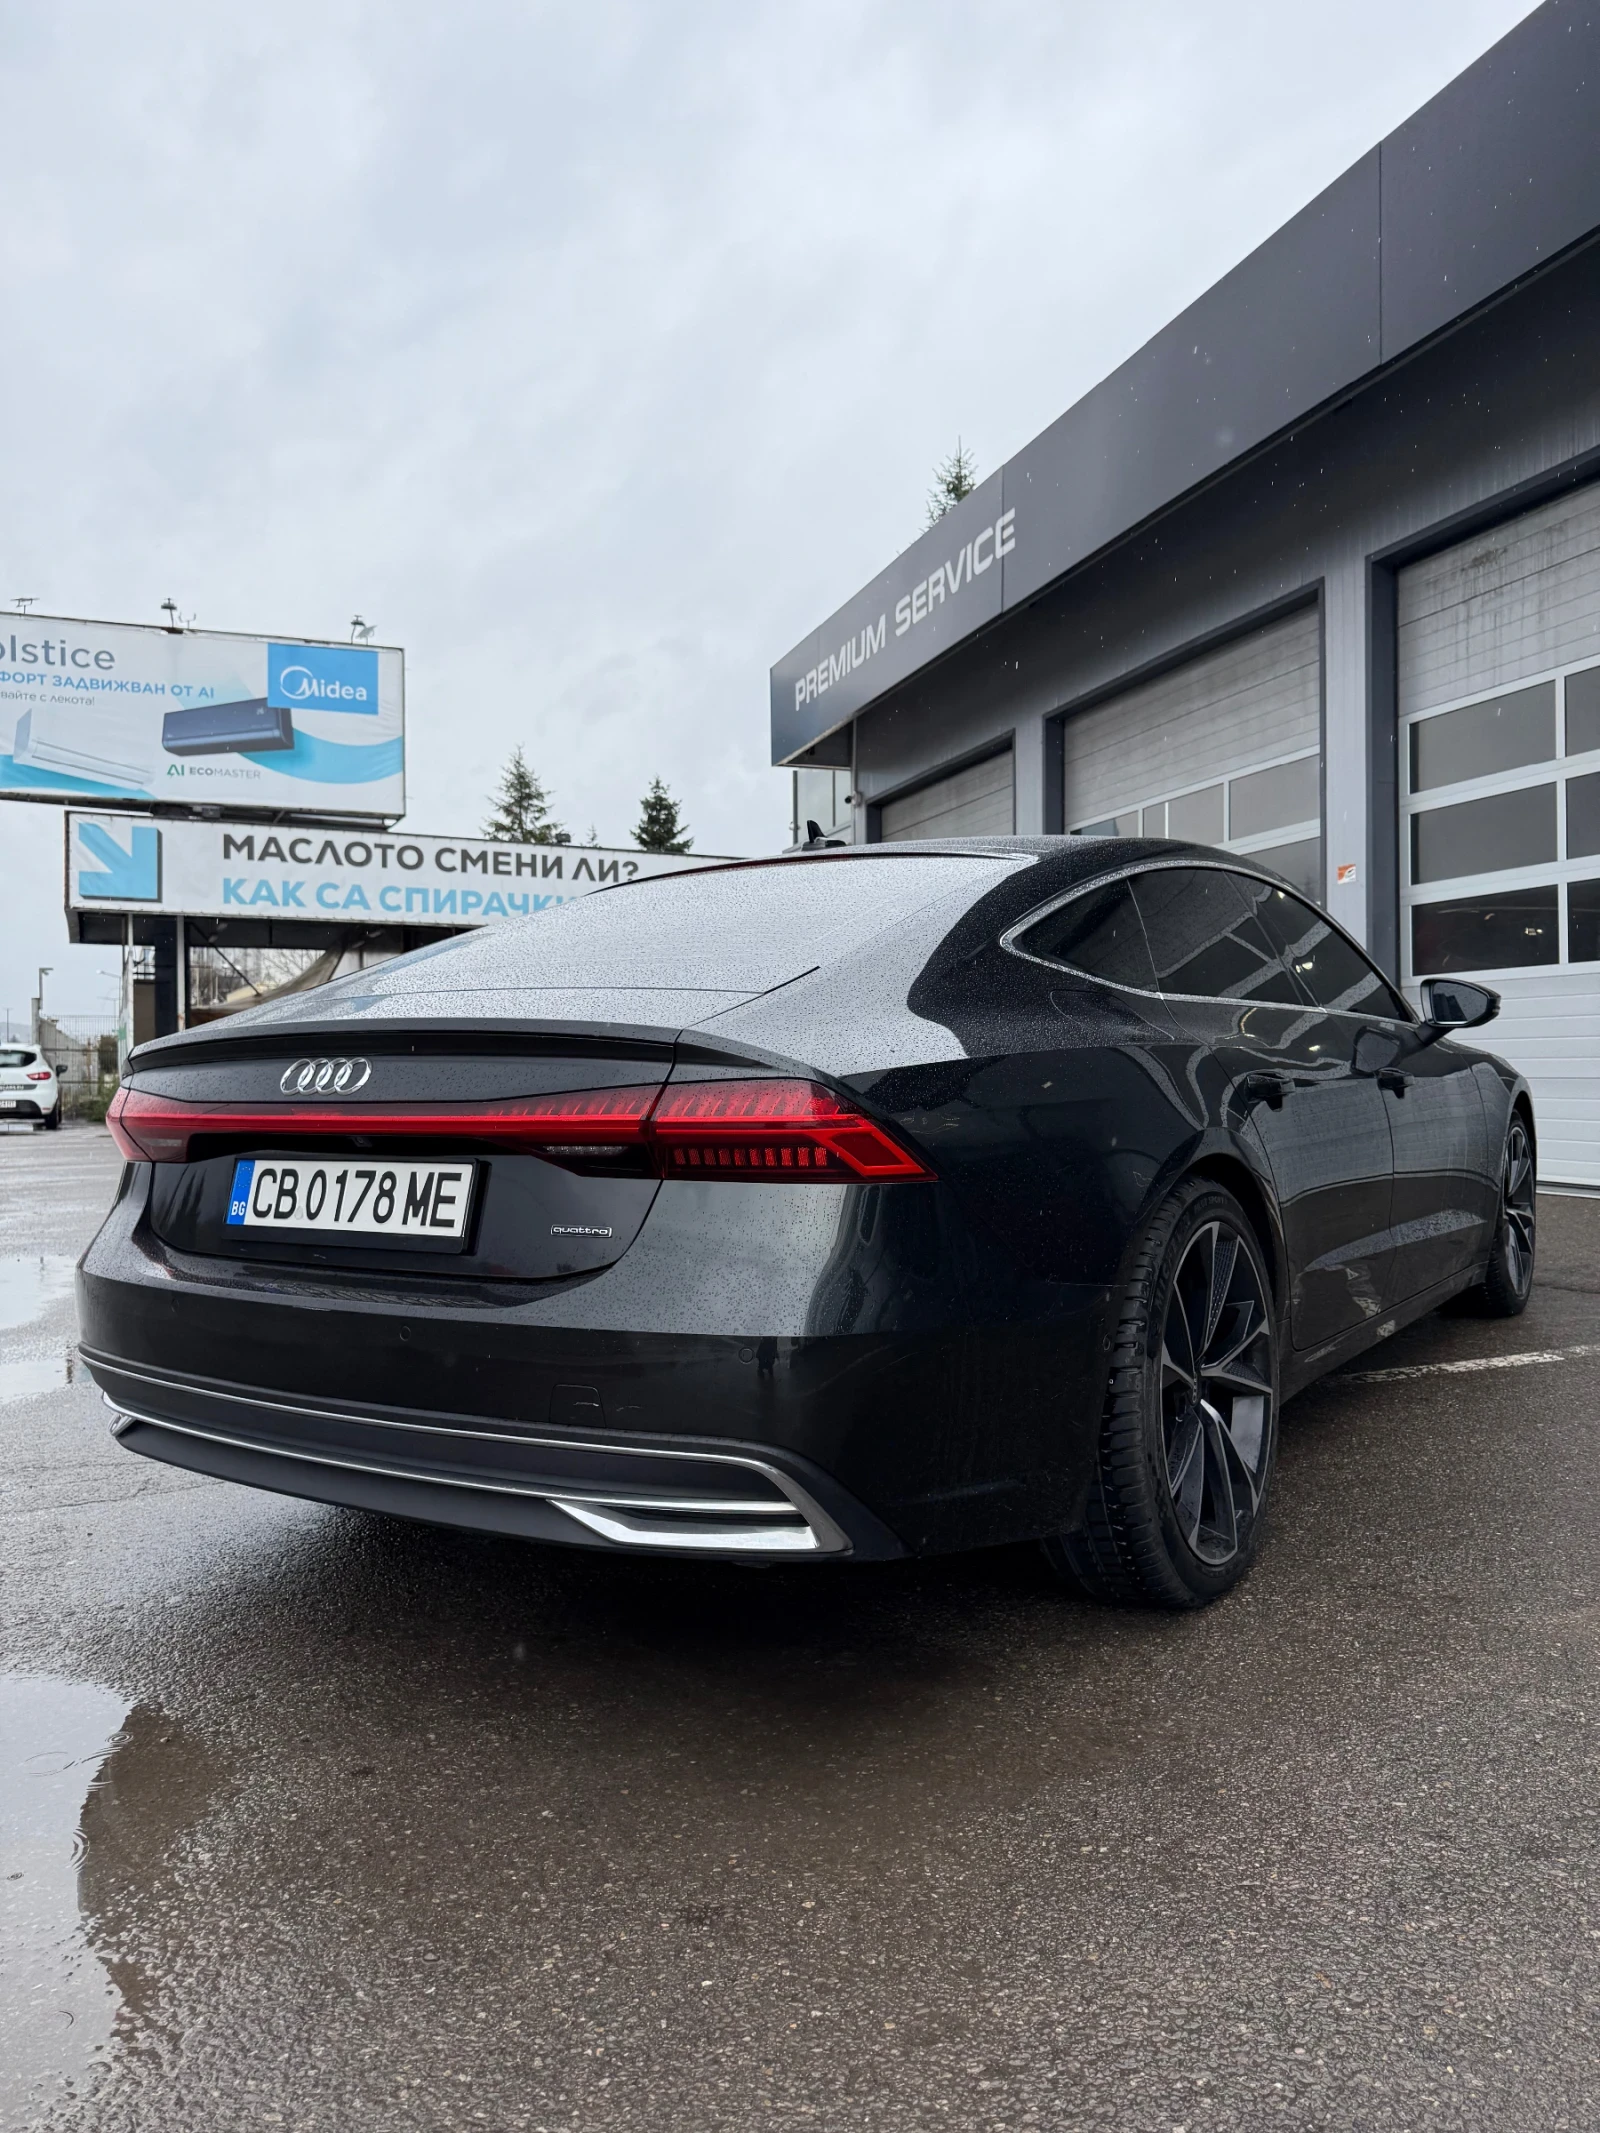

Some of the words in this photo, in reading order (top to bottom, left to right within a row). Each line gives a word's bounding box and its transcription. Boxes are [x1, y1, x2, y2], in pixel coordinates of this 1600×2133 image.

[795, 613, 886, 711] PREMIUM
[895, 507, 1016, 637] SERVICE
[0, 634, 115, 670] lstice
[52, 674, 166, 695] ЗАДВИЖВАН
[170, 684, 193, 697] ОТ
[294, 676, 367, 701] Midea
[189, 766, 261, 780] ECOMASTER
[223, 833, 424, 870] МАСЛОТО
[435, 847, 563, 879] СМЕНИ
[571, 857, 639, 883] ЛИ?
[223, 878, 307, 908] КАК
[315, 882, 372, 910] СА
[379, 886, 577, 916] СПИРАЧК
[231, 1201, 246, 1216] BG
[252, 1168, 299, 1219] CB
[306, 1169, 397, 1224] 0178
[402, 1172, 463, 1228] ME
[552, 1225, 609, 1236] quattro
